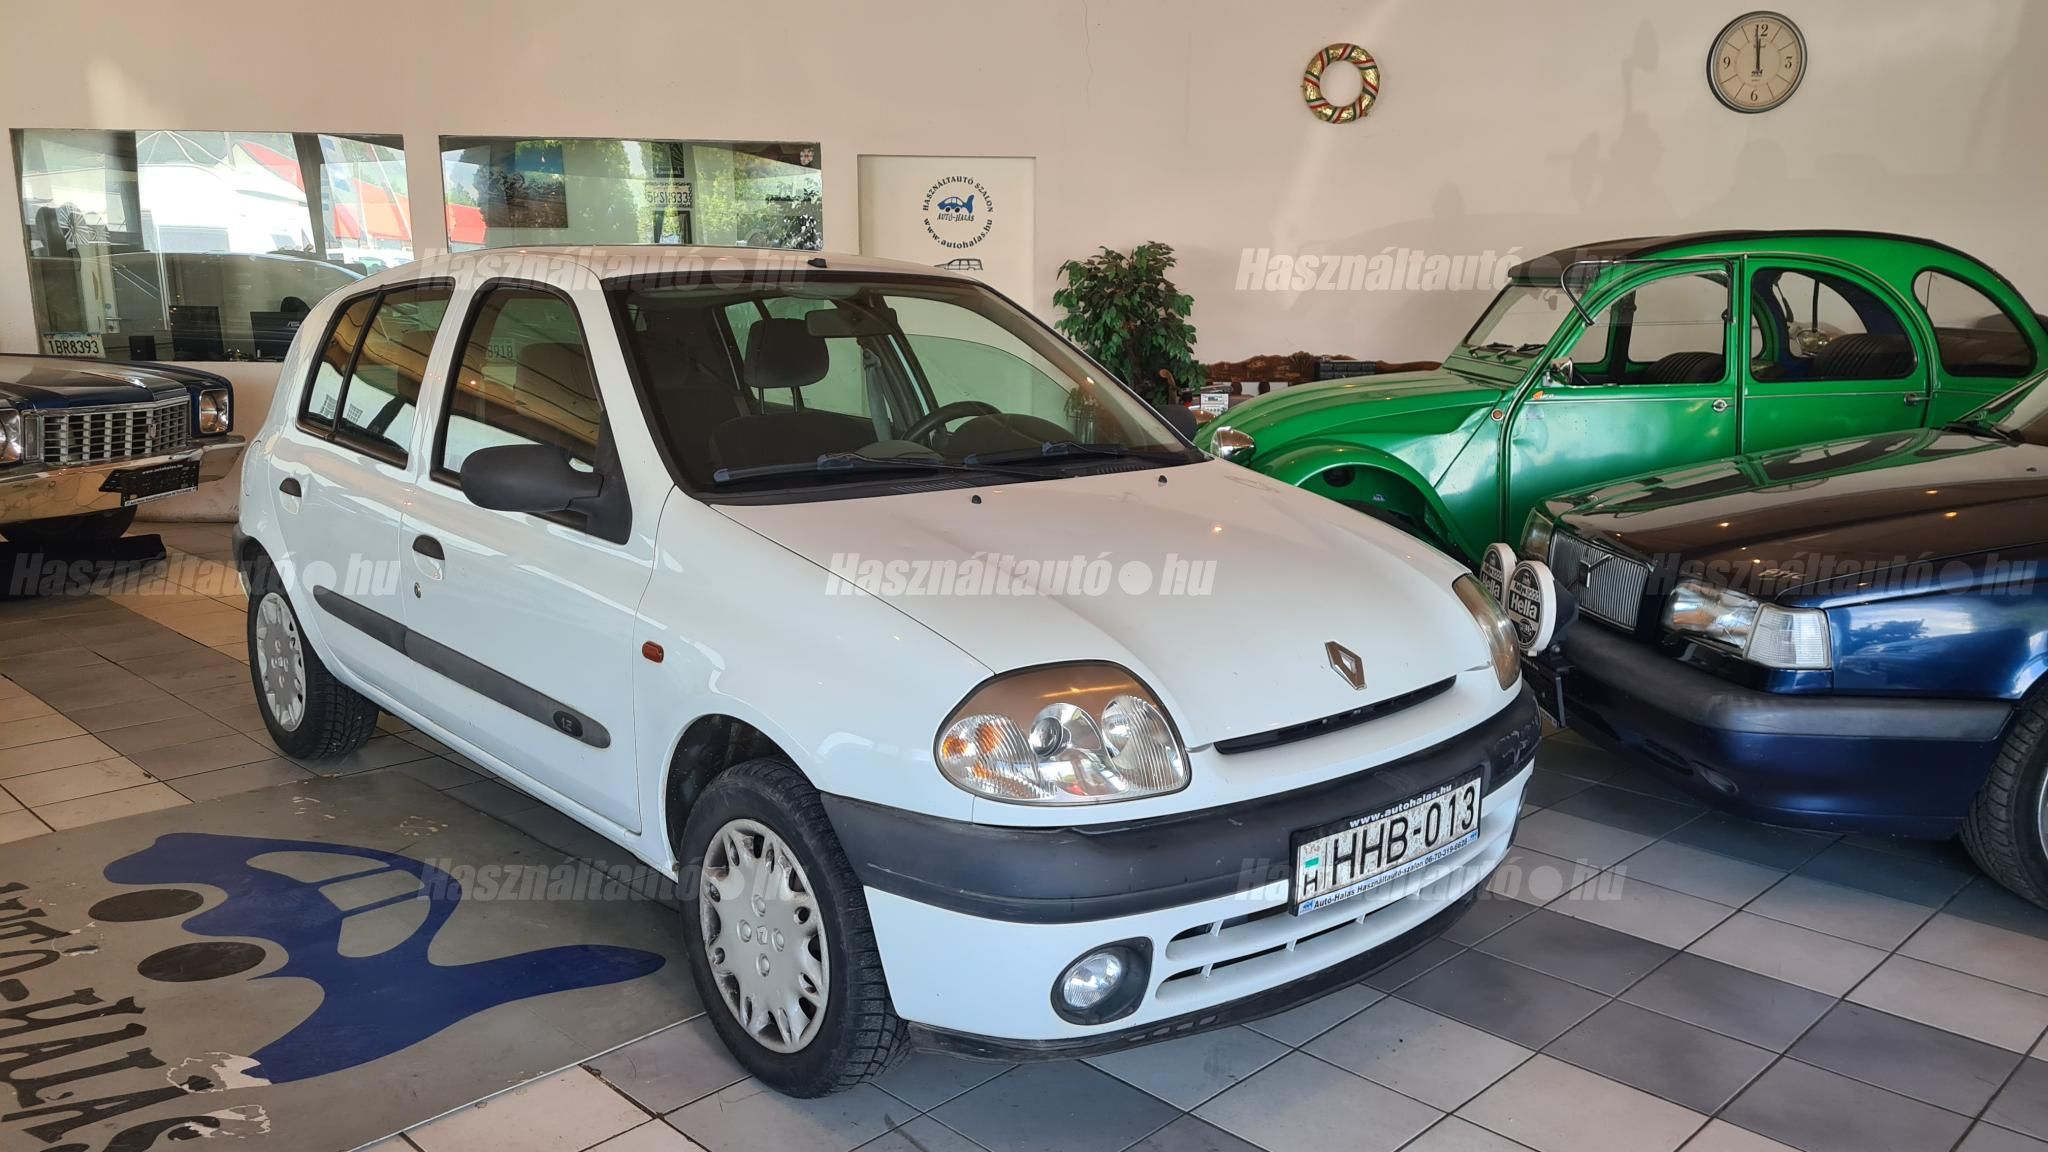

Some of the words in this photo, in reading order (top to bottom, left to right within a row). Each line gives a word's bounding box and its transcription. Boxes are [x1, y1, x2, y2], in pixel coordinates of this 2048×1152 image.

[1723, 56, 1731, 70] 9
[1784, 55, 1793, 69] 3
[1750, 88, 1758, 101] 6
[974, 183, 994, 212] SZALON
[924, 218, 993, 249] www.autohalas.hu
[48, 340, 100, 354] 1BR8393
[1510, 592, 1538, 620] Hella
[1350, 784, 1453, 828] www.autohalas.hu
[1332, 786, 1476, 886] HHB-013
[1303, 869, 1318, 896] H
